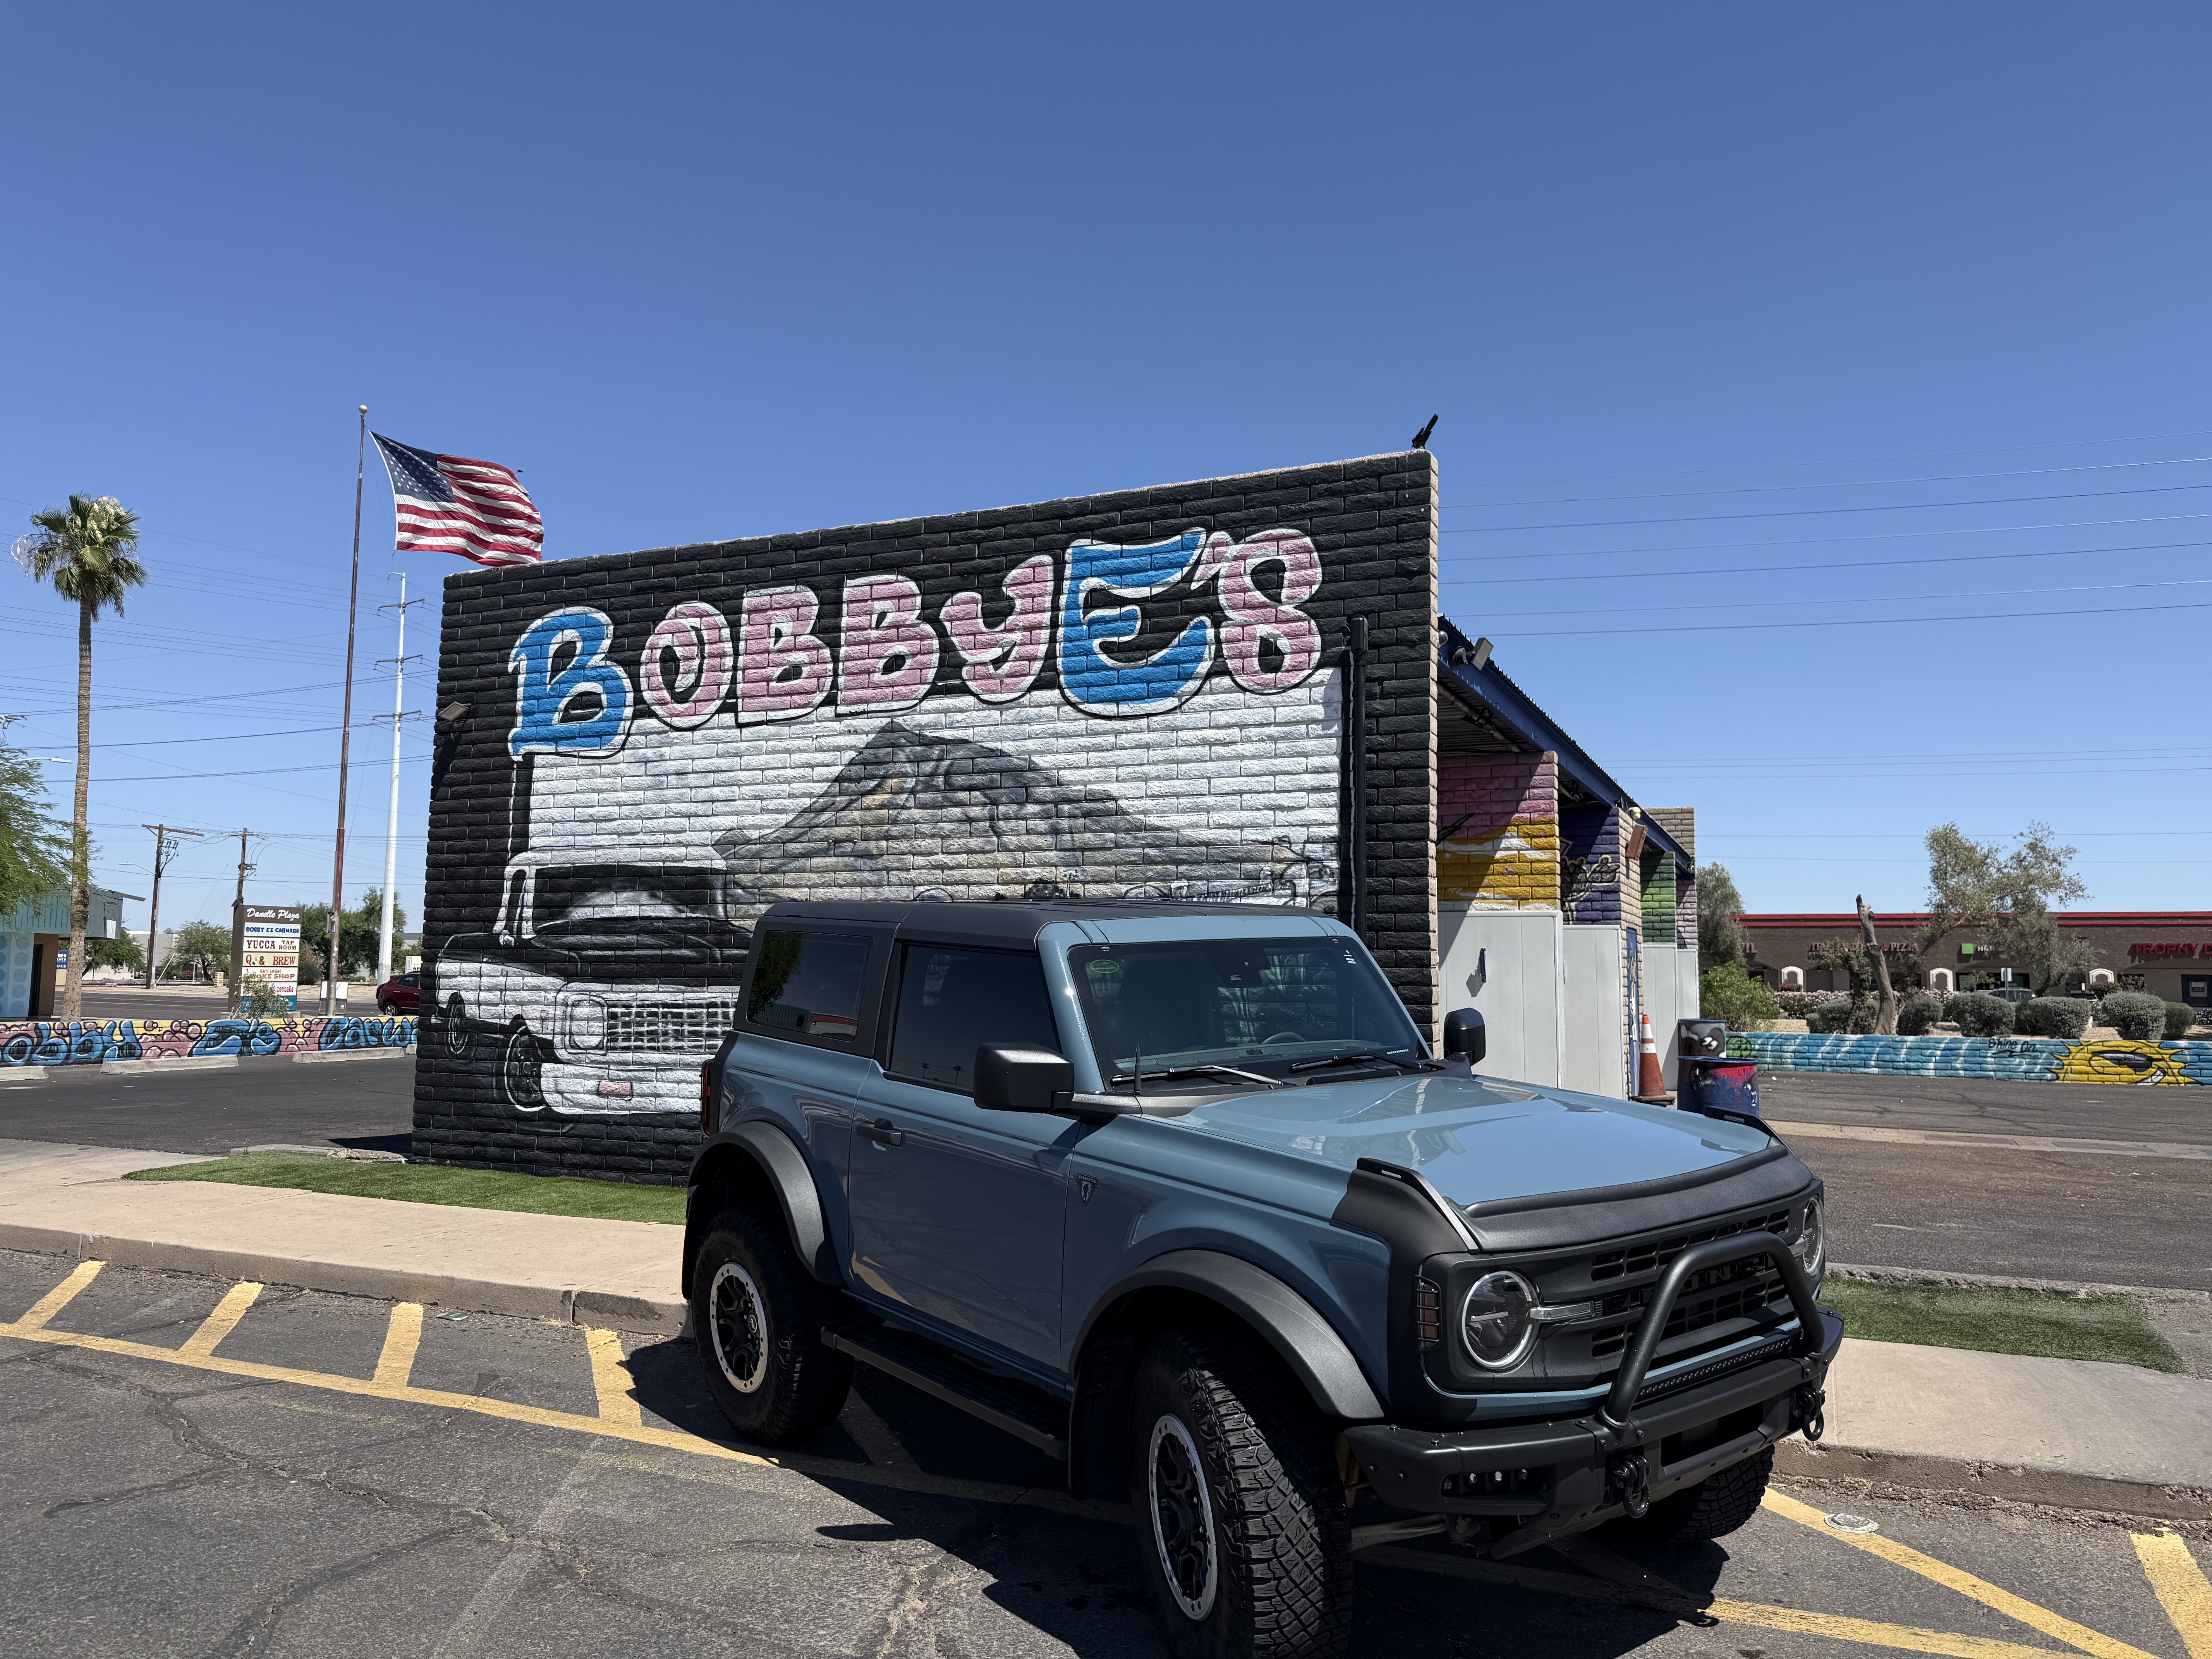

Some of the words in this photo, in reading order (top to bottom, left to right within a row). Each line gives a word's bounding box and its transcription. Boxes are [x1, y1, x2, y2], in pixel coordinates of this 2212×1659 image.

[247, 908, 276, 918] Danelle
[278, 909, 300, 922] Plaza
[246, 940, 276, 949] YUCCA
[2132, 943, 2200, 955] TROPHY
[259, 955, 265, 965] &
[273, 956, 296, 965] BREW
[1988, 1038, 2017, 1049] Shine
[2020, 1041, 2037, 1053] On
